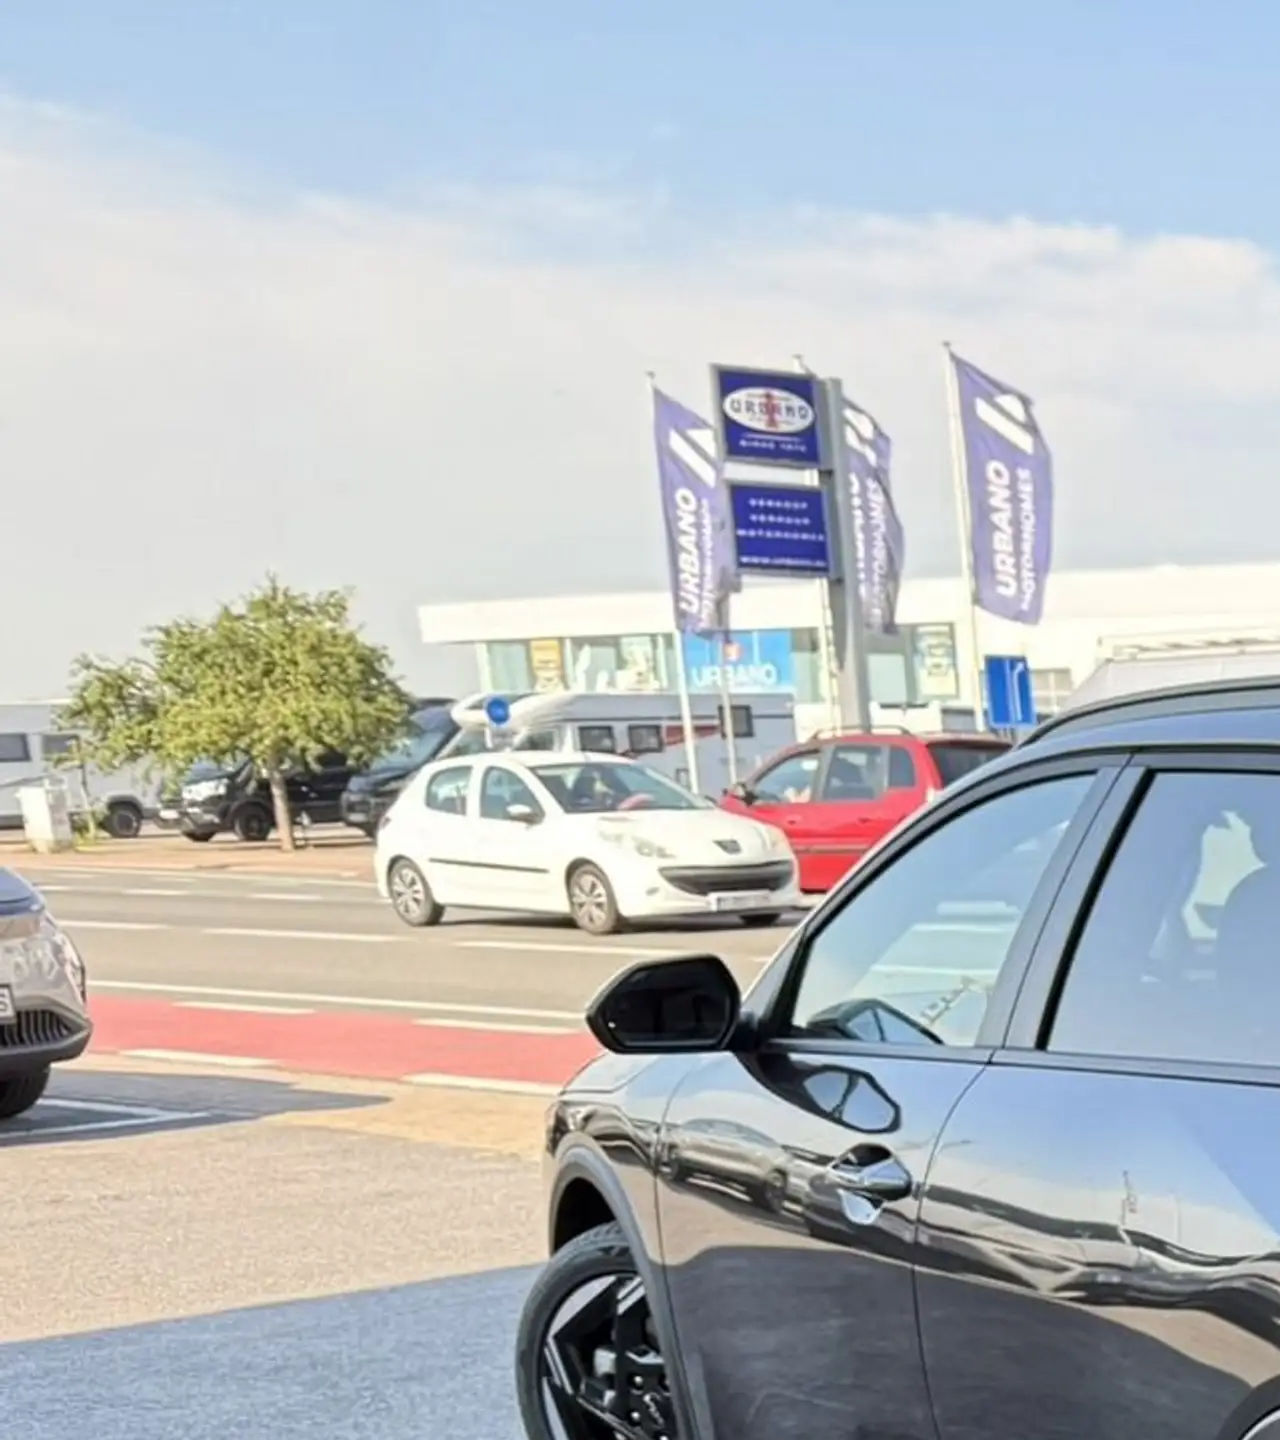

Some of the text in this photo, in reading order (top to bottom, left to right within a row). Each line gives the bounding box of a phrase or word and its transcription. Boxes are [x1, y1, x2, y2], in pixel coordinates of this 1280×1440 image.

[675, 487, 701, 614] URBANO
[986, 459, 1018, 597] URBANO
[1016, 467, 1037, 612] MOTORHOMES
[690, 663, 779, 687] URBANO
